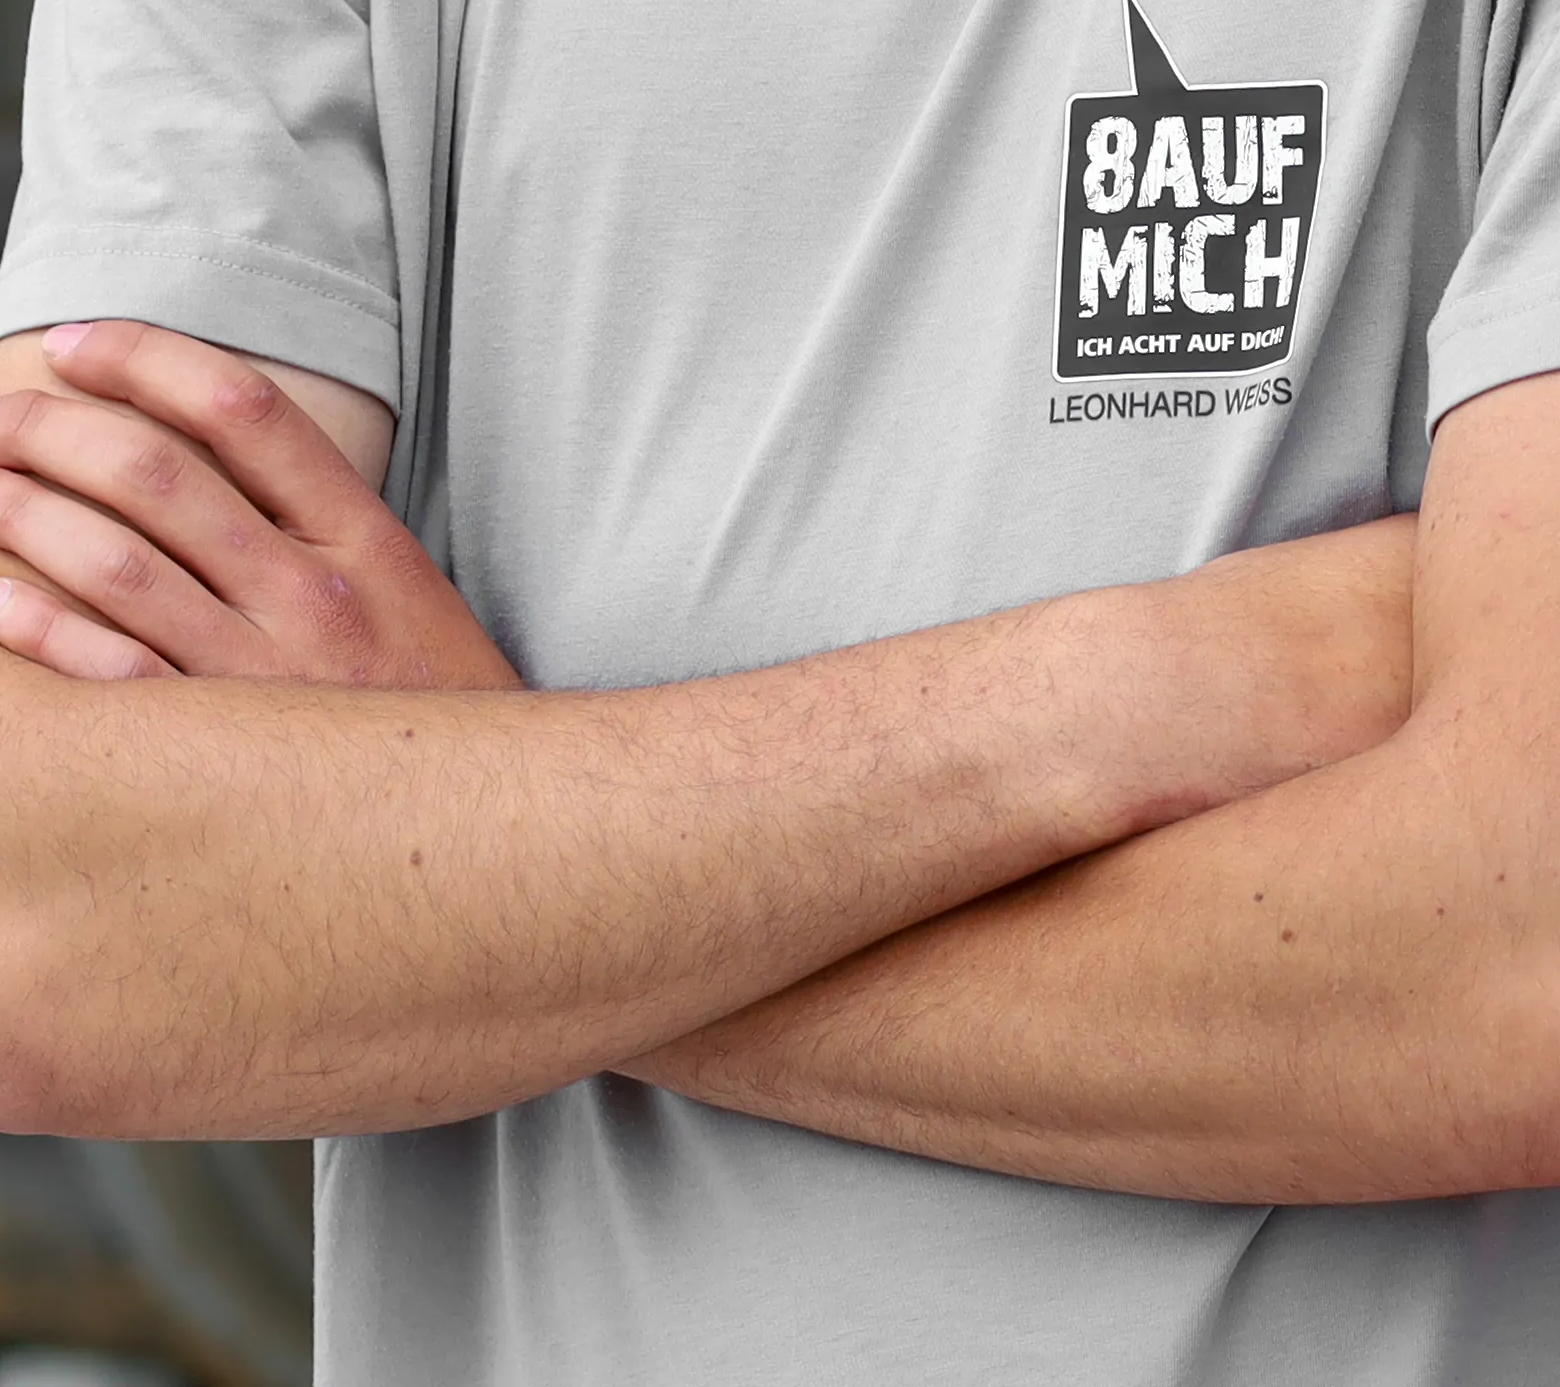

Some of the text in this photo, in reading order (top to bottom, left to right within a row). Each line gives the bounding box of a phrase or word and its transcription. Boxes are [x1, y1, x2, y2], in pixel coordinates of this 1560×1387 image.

[1083, 114, 1306, 214] 8AUF
[1077, 213, 1302, 318] MICH
[1076, 325, 1285, 358] ICH ACHT AUF DICH!
[1049, 376, 1294, 424] LEONHARD WEISS
